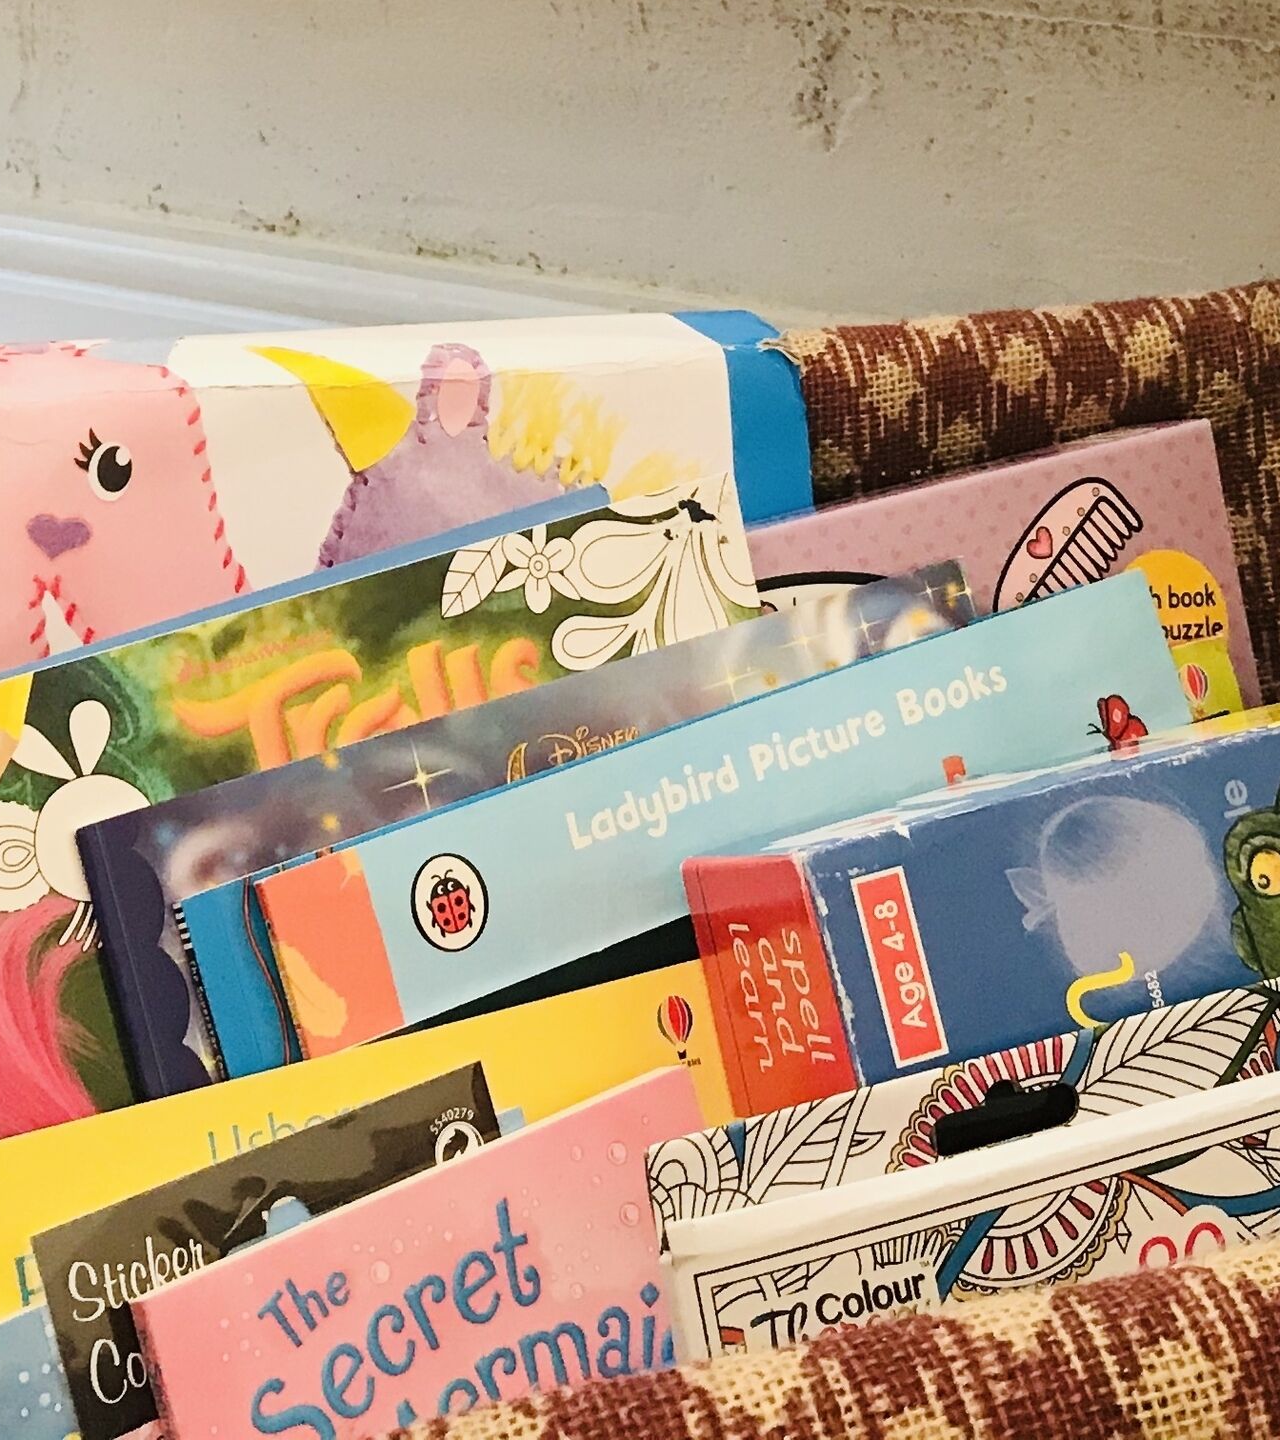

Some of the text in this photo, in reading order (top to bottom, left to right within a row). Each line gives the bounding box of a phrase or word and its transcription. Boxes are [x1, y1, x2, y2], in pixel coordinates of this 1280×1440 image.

[1168, 583, 1217, 609] book
[565, 755, 739, 849] Ladybird
[748, 710, 886, 781] Picture
[895, 664, 1008, 725] Books
[728, 923, 774, 1072] learn
[758, 936, 805, 1056] and
[781, 927, 836, 1064] spell
[873, 899, 927, 1028] Age 4-8
[68, 1236, 205, 1322] Sticker
[251, 1197, 541, 1440] Secret
[258, 1271, 351, 1348] The
[815, 1273, 925, 1325] Colour
[396, 1281, 675, 1428] ermai
